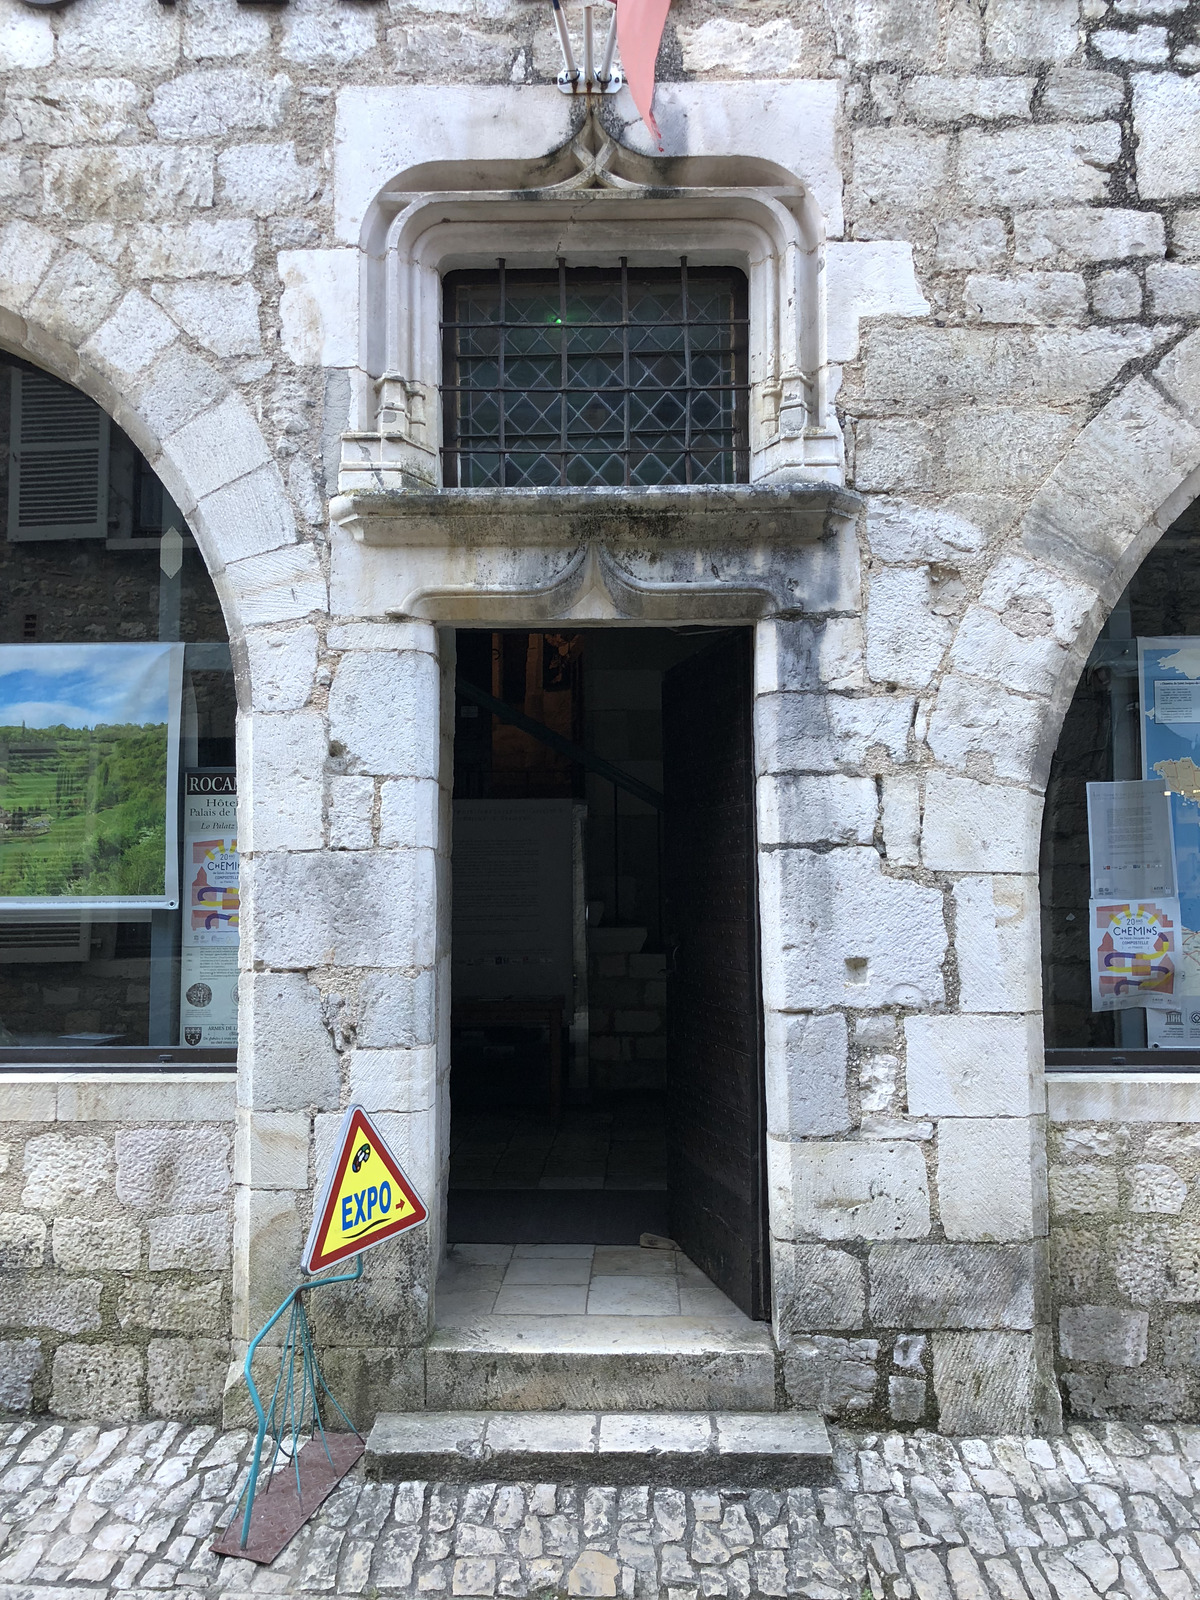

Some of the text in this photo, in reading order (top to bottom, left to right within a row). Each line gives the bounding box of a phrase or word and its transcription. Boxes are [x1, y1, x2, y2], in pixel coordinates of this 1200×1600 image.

[189, 777, 237, 791] ROCA
[190, 808, 216, 816] Palais
[219, 808, 230, 816] de
[1113, 926, 1157, 935] CHEMINS
[342, 1181, 391, 1231] EXPO
